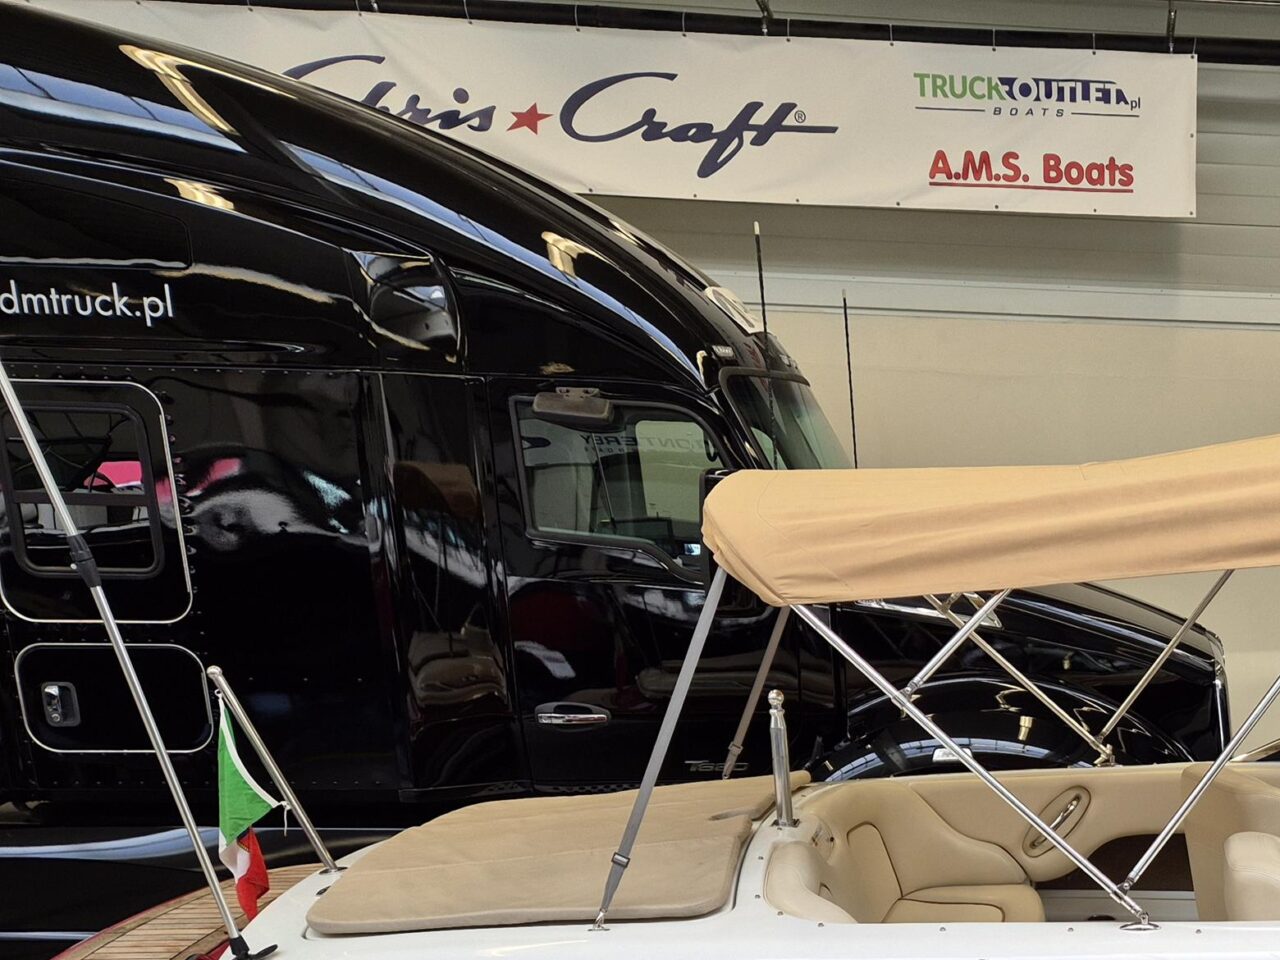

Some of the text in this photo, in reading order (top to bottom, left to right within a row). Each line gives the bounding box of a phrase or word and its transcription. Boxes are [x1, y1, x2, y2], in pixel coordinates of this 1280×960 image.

[992, 106, 1065, 118] BOATS
[928, 149, 1135, 187] A.M.S. Boats
[0, 279, 175, 328] dmtruck.pl
